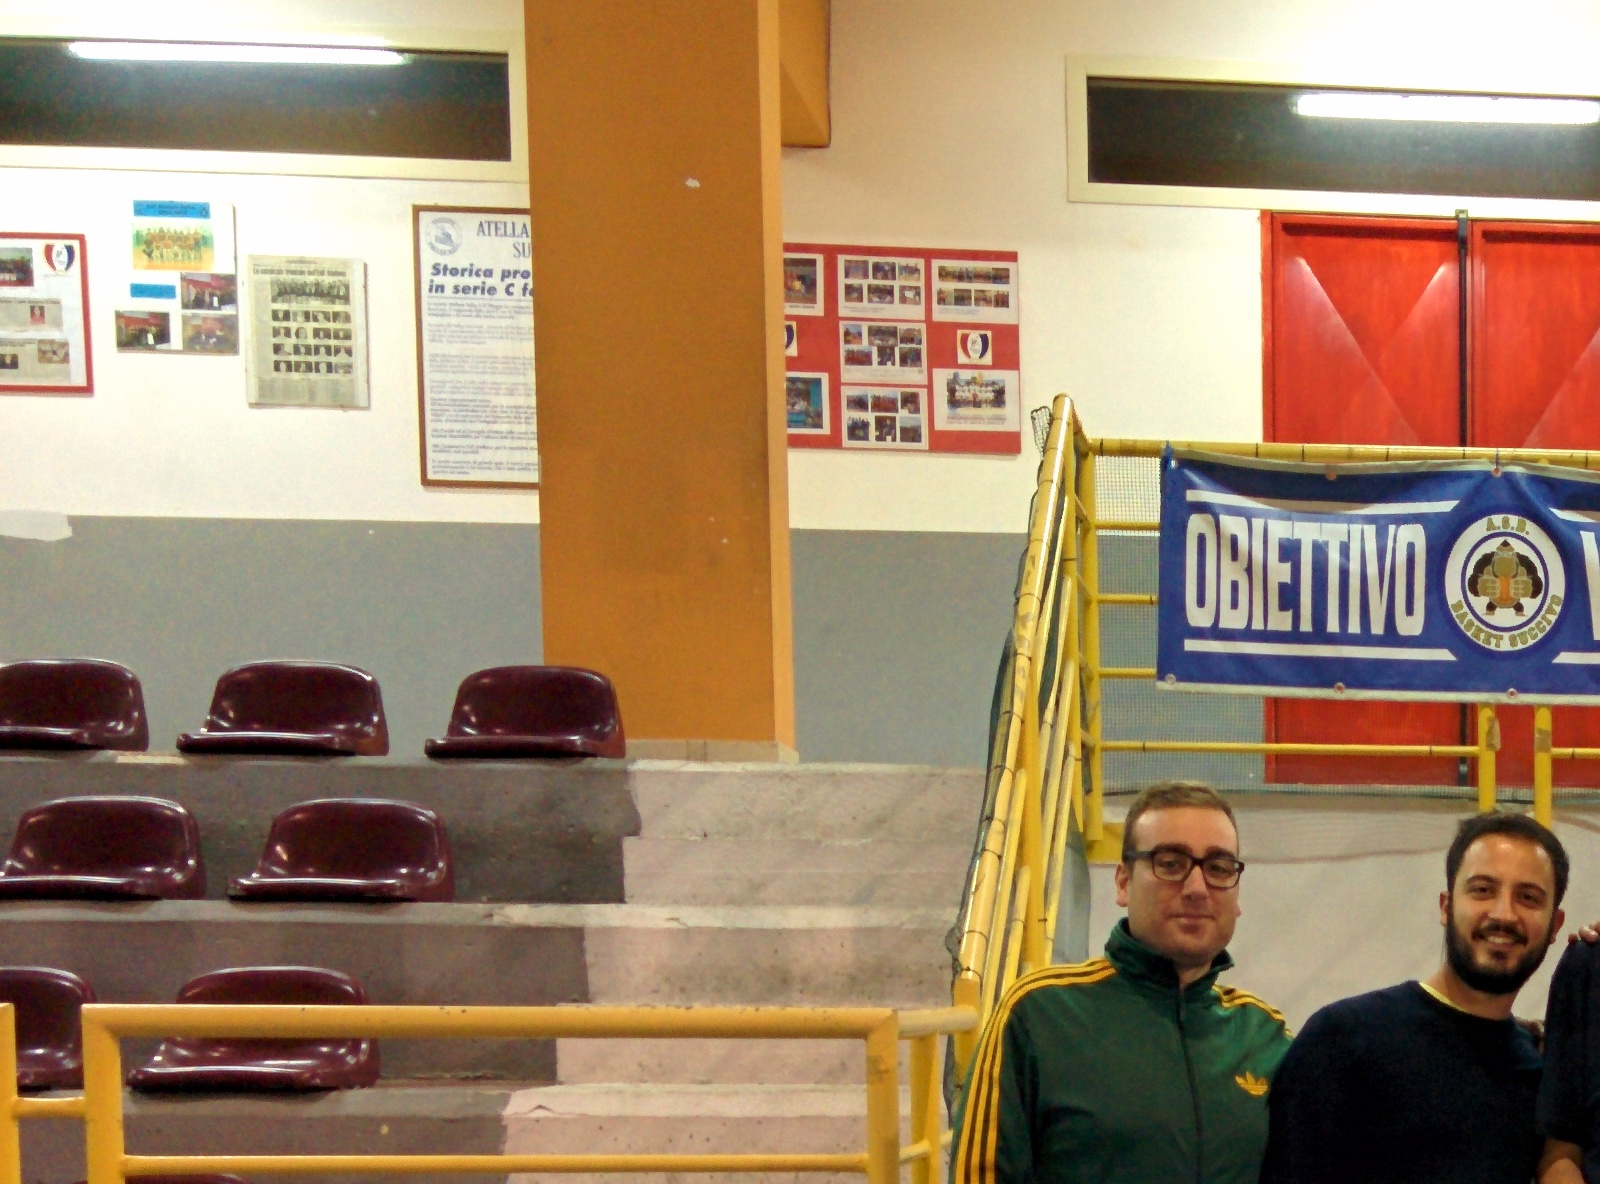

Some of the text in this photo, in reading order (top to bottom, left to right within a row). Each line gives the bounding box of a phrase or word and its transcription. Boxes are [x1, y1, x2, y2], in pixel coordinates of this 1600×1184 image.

[476, 221, 529, 238] ATELLA
[431, 262, 494, 278] Storica
[428, 279, 445, 294] in
[452, 281, 497, 296] serie
[505, 283, 515, 296] C
[1185, 513, 1427, 637] OBIETTIVO
[1450, 594, 1563, 648] BASKET SUCCIVO
